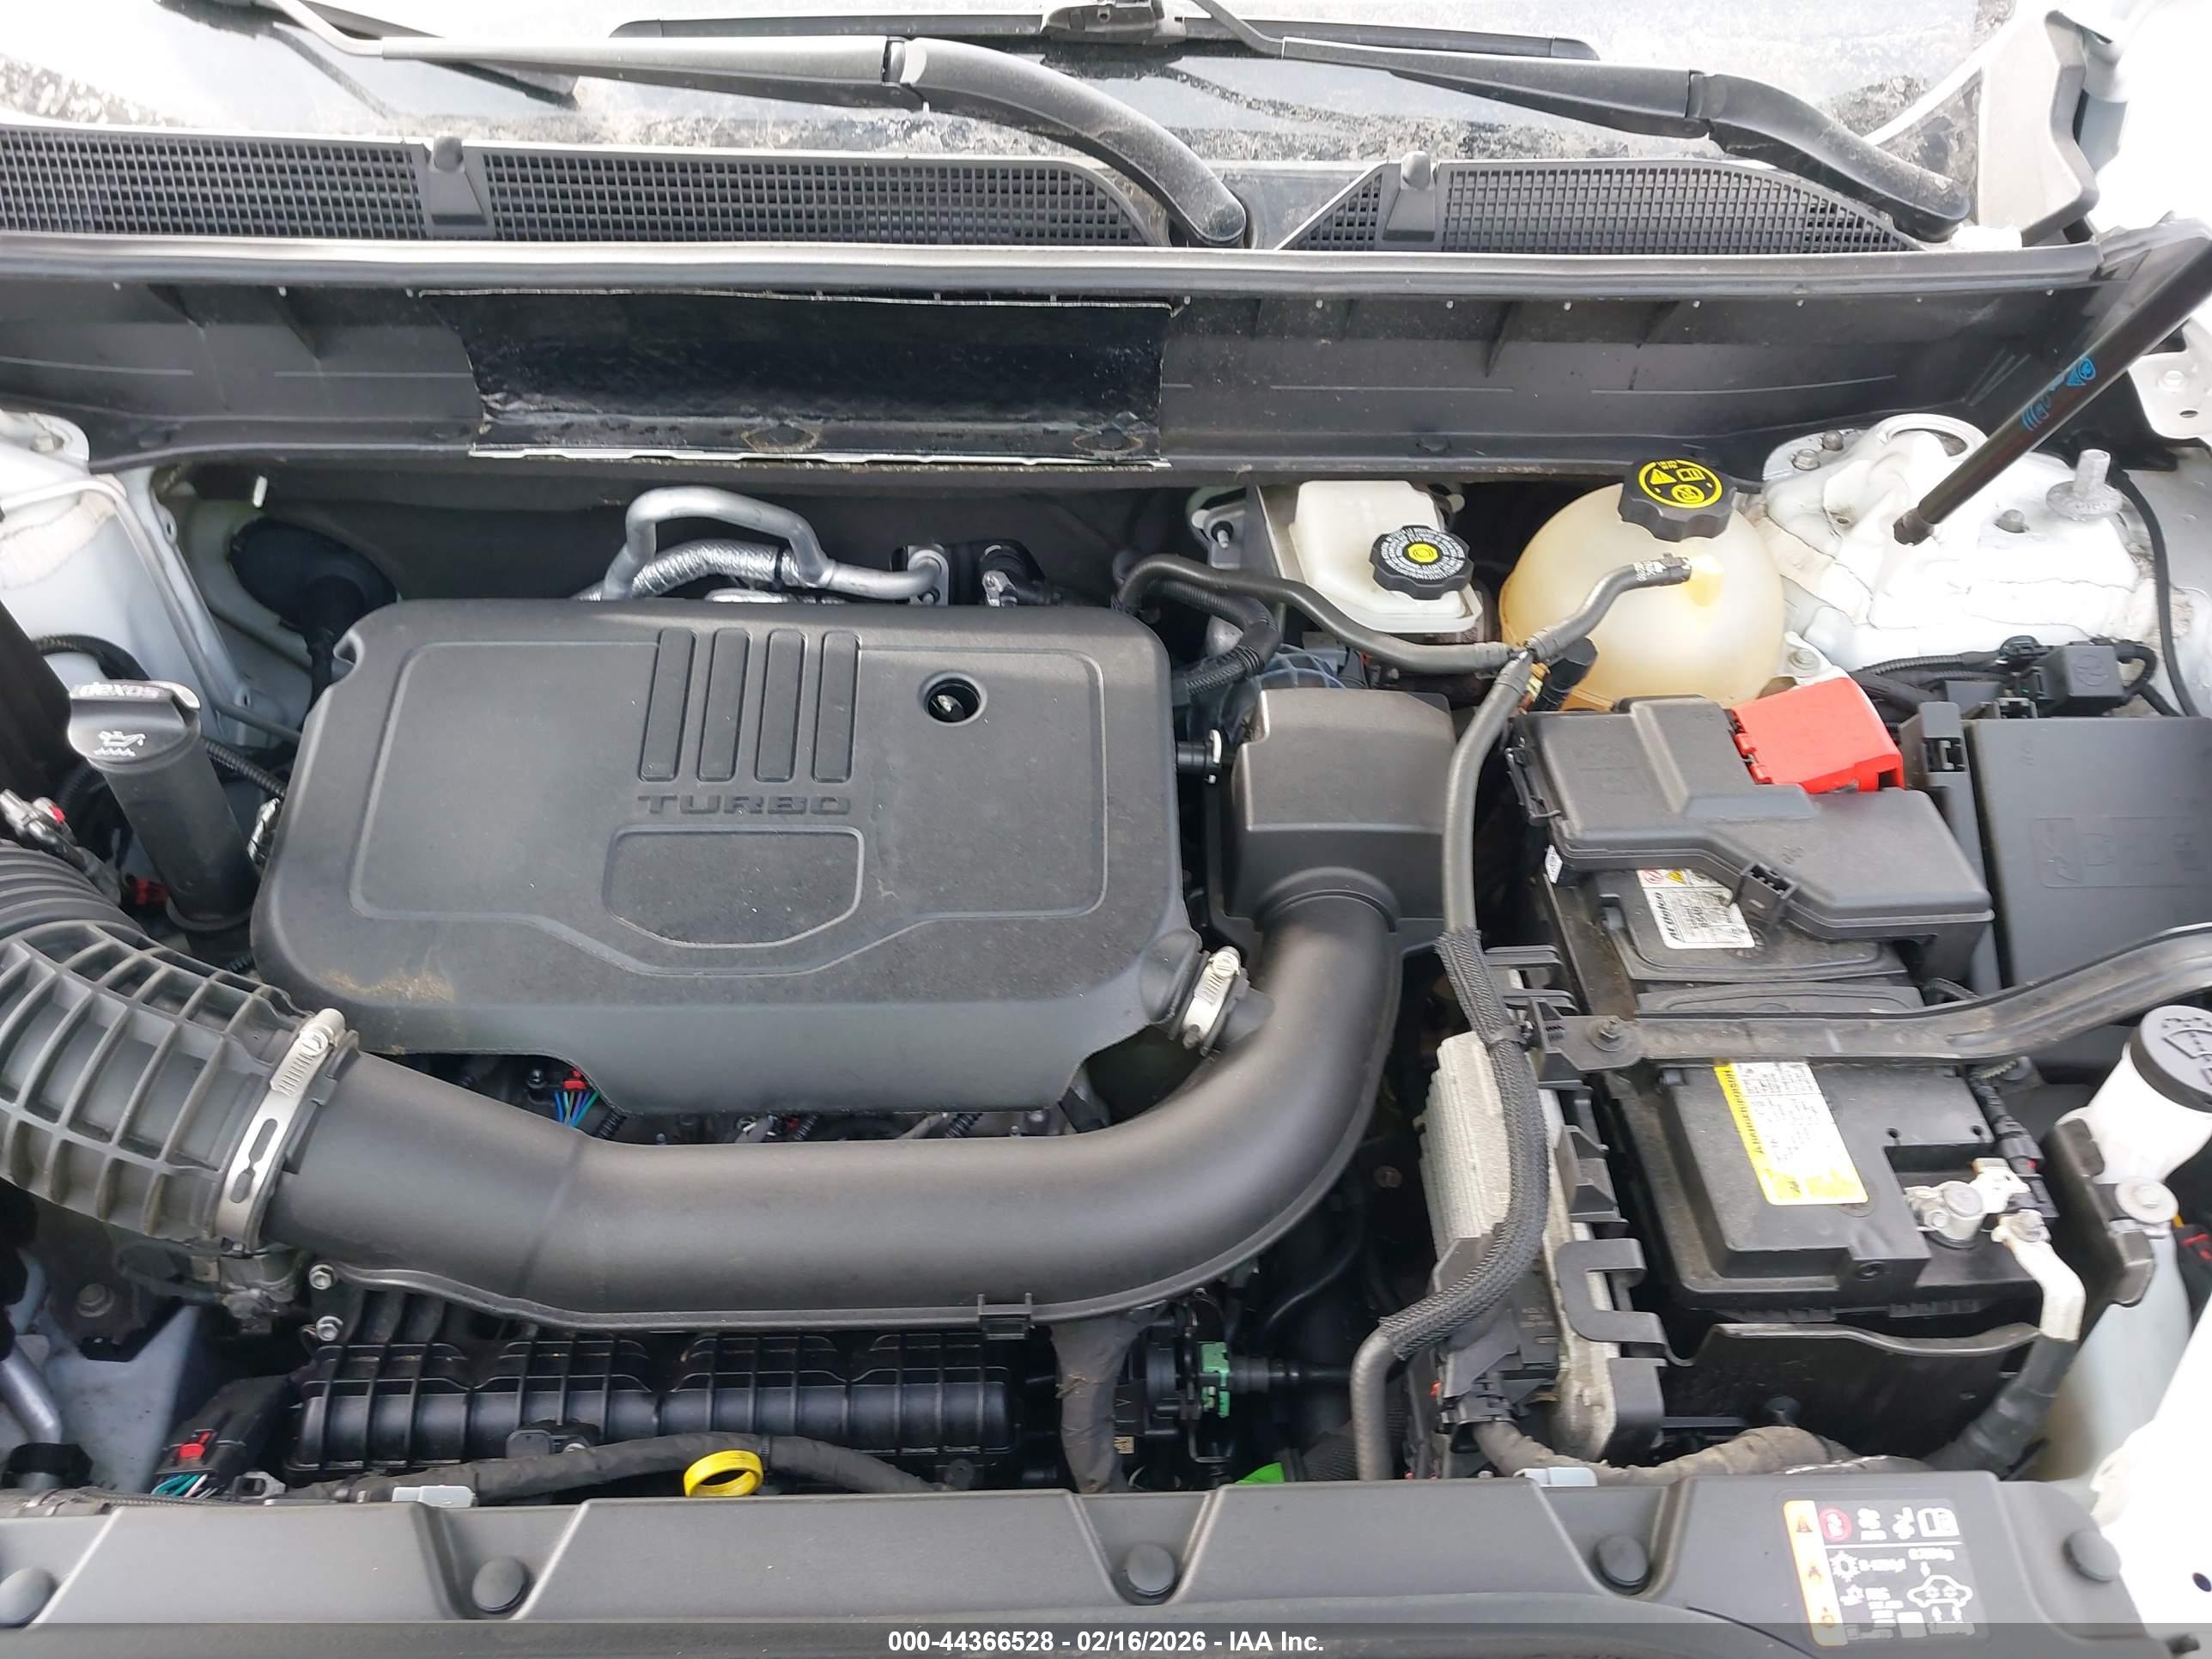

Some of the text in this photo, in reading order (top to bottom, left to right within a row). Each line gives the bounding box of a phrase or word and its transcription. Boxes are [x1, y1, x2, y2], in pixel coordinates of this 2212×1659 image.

[79, 681, 160, 698] dexos
[637, 794, 852, 815] TURBO
[1654, 891, 1682, 942] ACDelco
